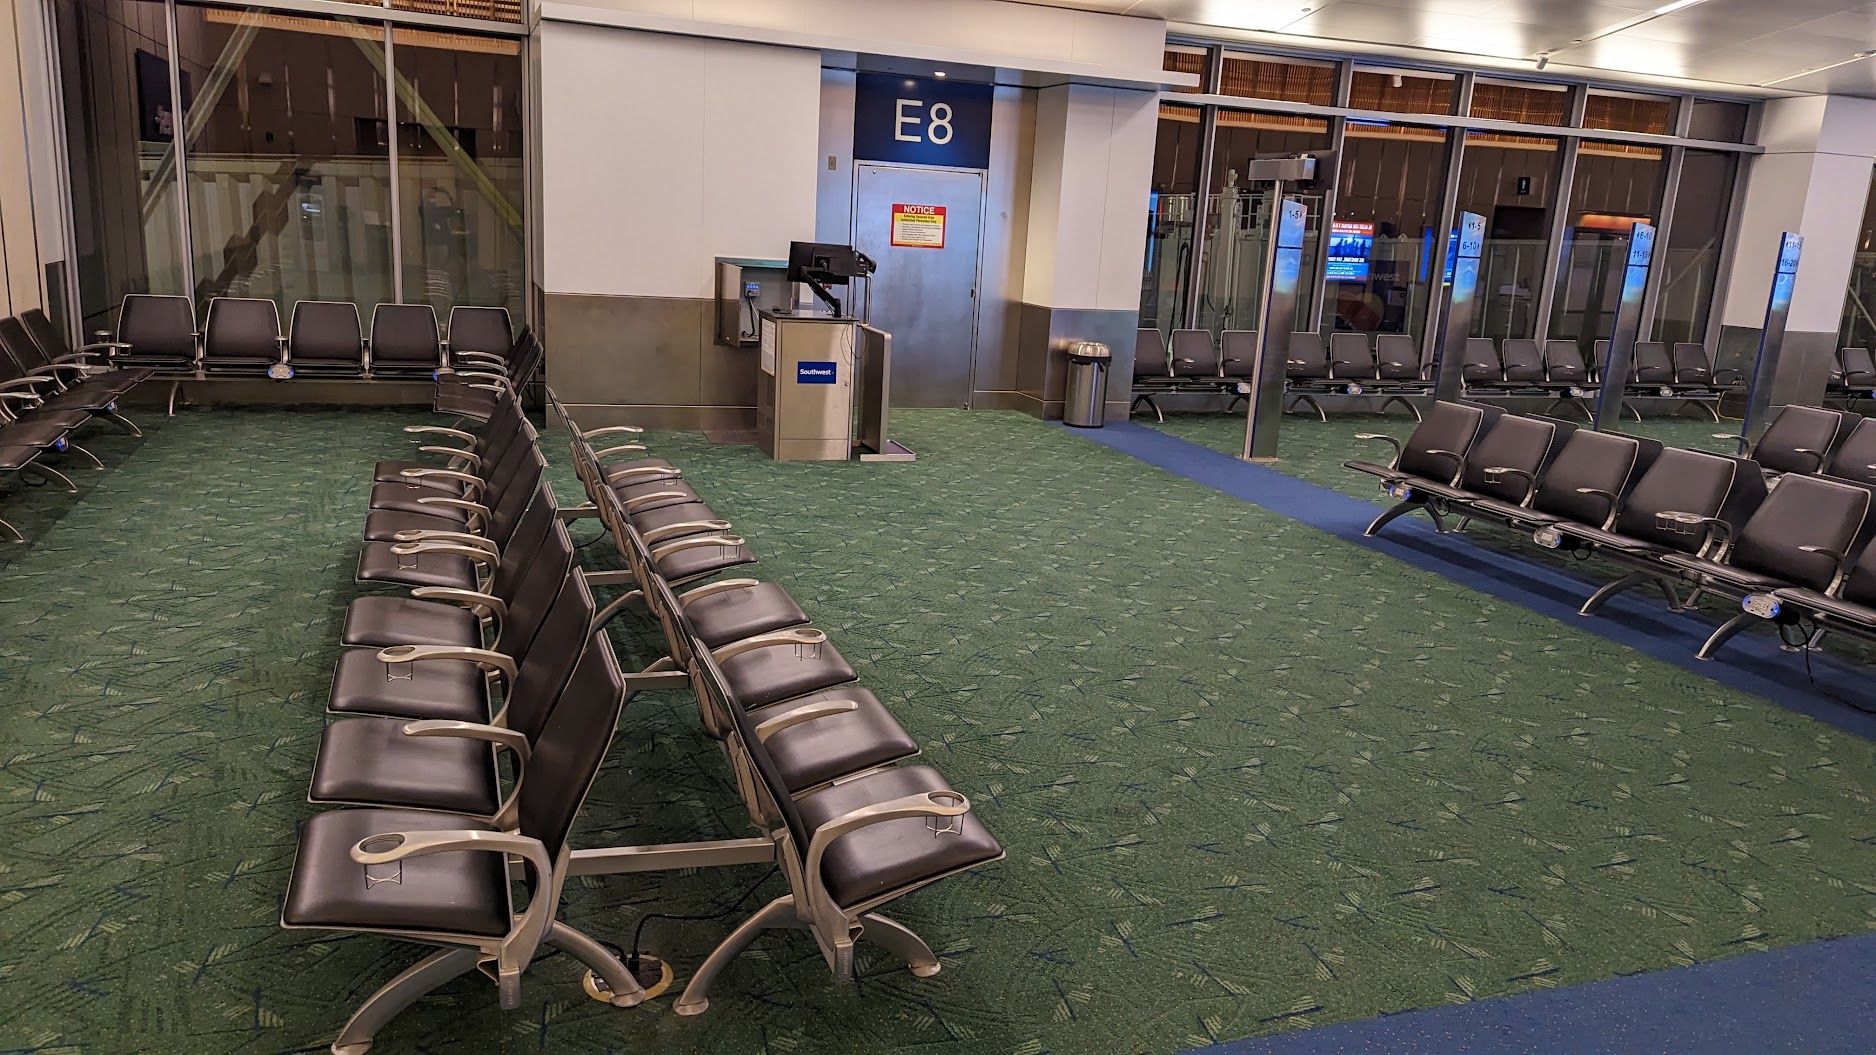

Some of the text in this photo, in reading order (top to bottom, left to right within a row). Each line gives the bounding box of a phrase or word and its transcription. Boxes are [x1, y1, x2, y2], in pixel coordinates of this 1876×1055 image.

[894, 98, 954, 145] E8
[903, 205, 936, 214] NOTICE
[1462, 241, 1477, 250] 6-10
[800, 368, 832, 376] Southwest
